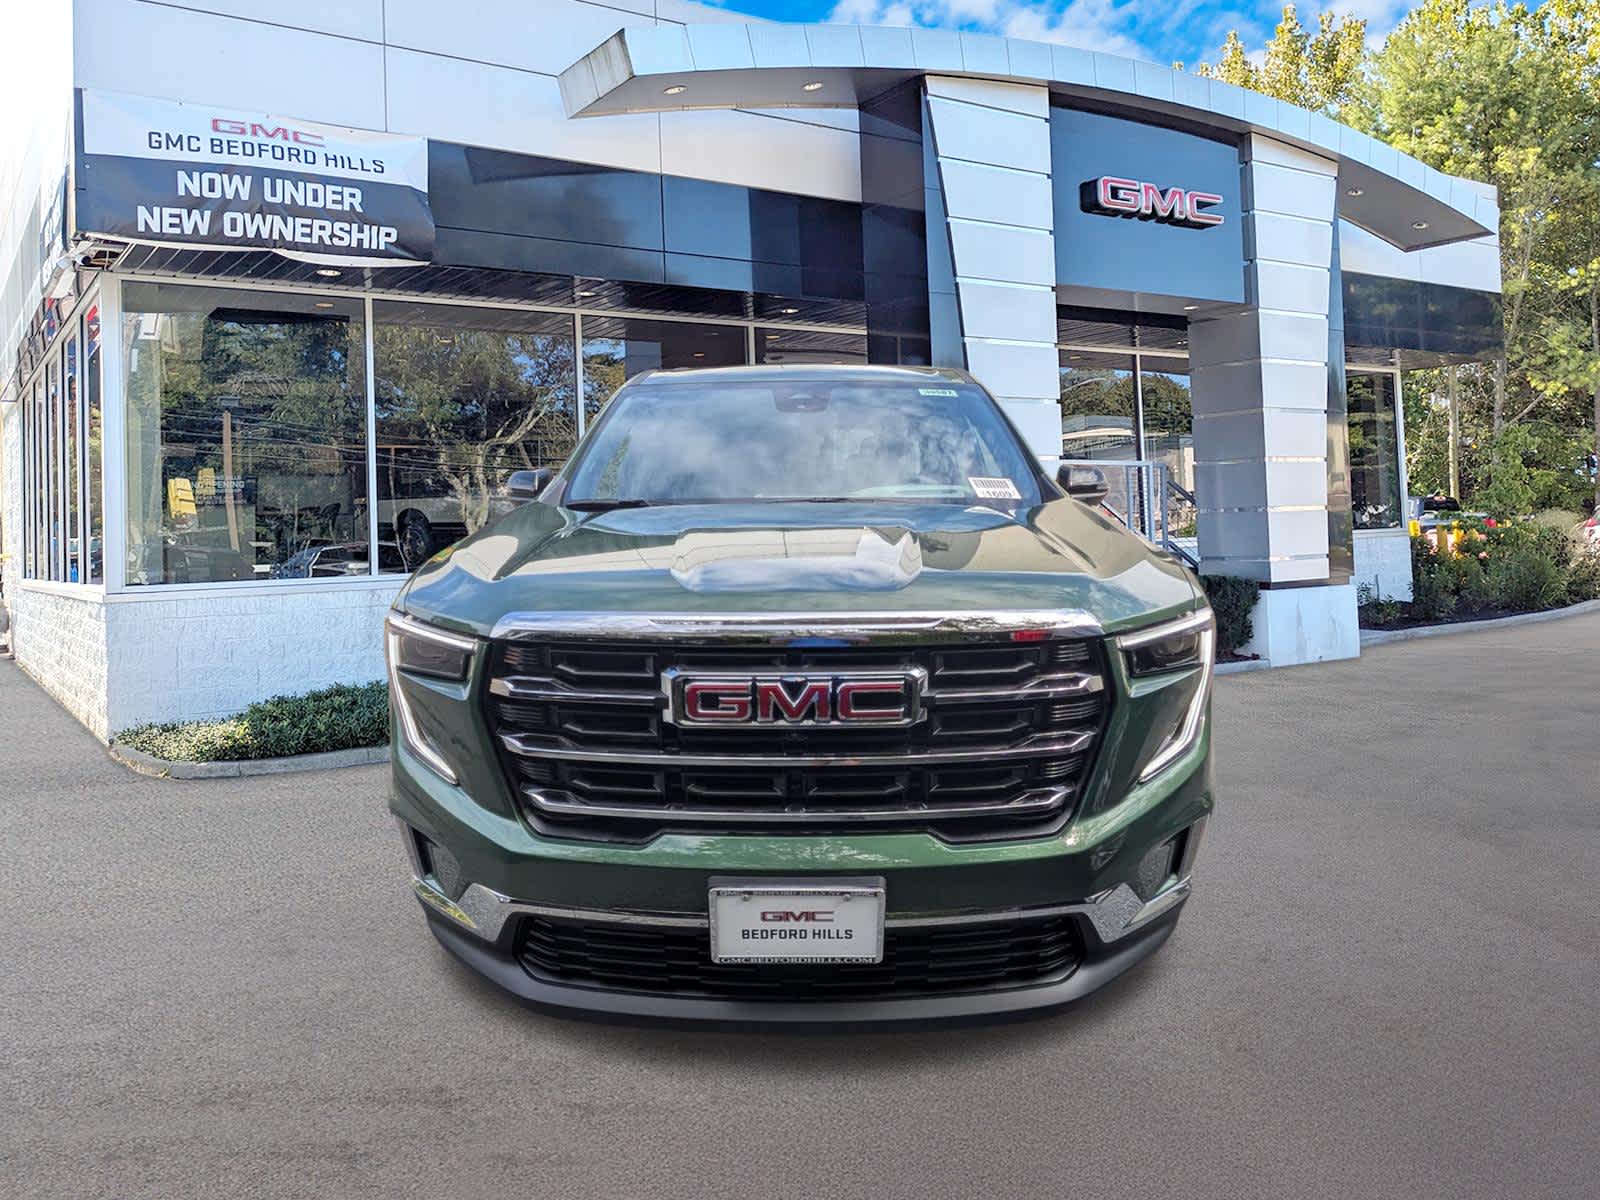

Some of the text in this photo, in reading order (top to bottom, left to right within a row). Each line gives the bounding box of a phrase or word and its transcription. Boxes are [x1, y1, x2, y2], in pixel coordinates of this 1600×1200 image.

[148, 131, 385, 174] GMC BEDFORD HILLS
[210, 117, 326, 148] GMC
[176, 170, 364, 213] NOW UNDER
[1097, 175, 1225, 225] GMC
[136, 205, 398, 250] NEW OWNERSHIP
[684, 680, 905, 722] GMC
[741, 929, 853, 940] BEDFORD HILLS
[760, 911, 834, 922] GMC
[720, 956, 873, 964] GMCBEDFORDHILLS.COM
